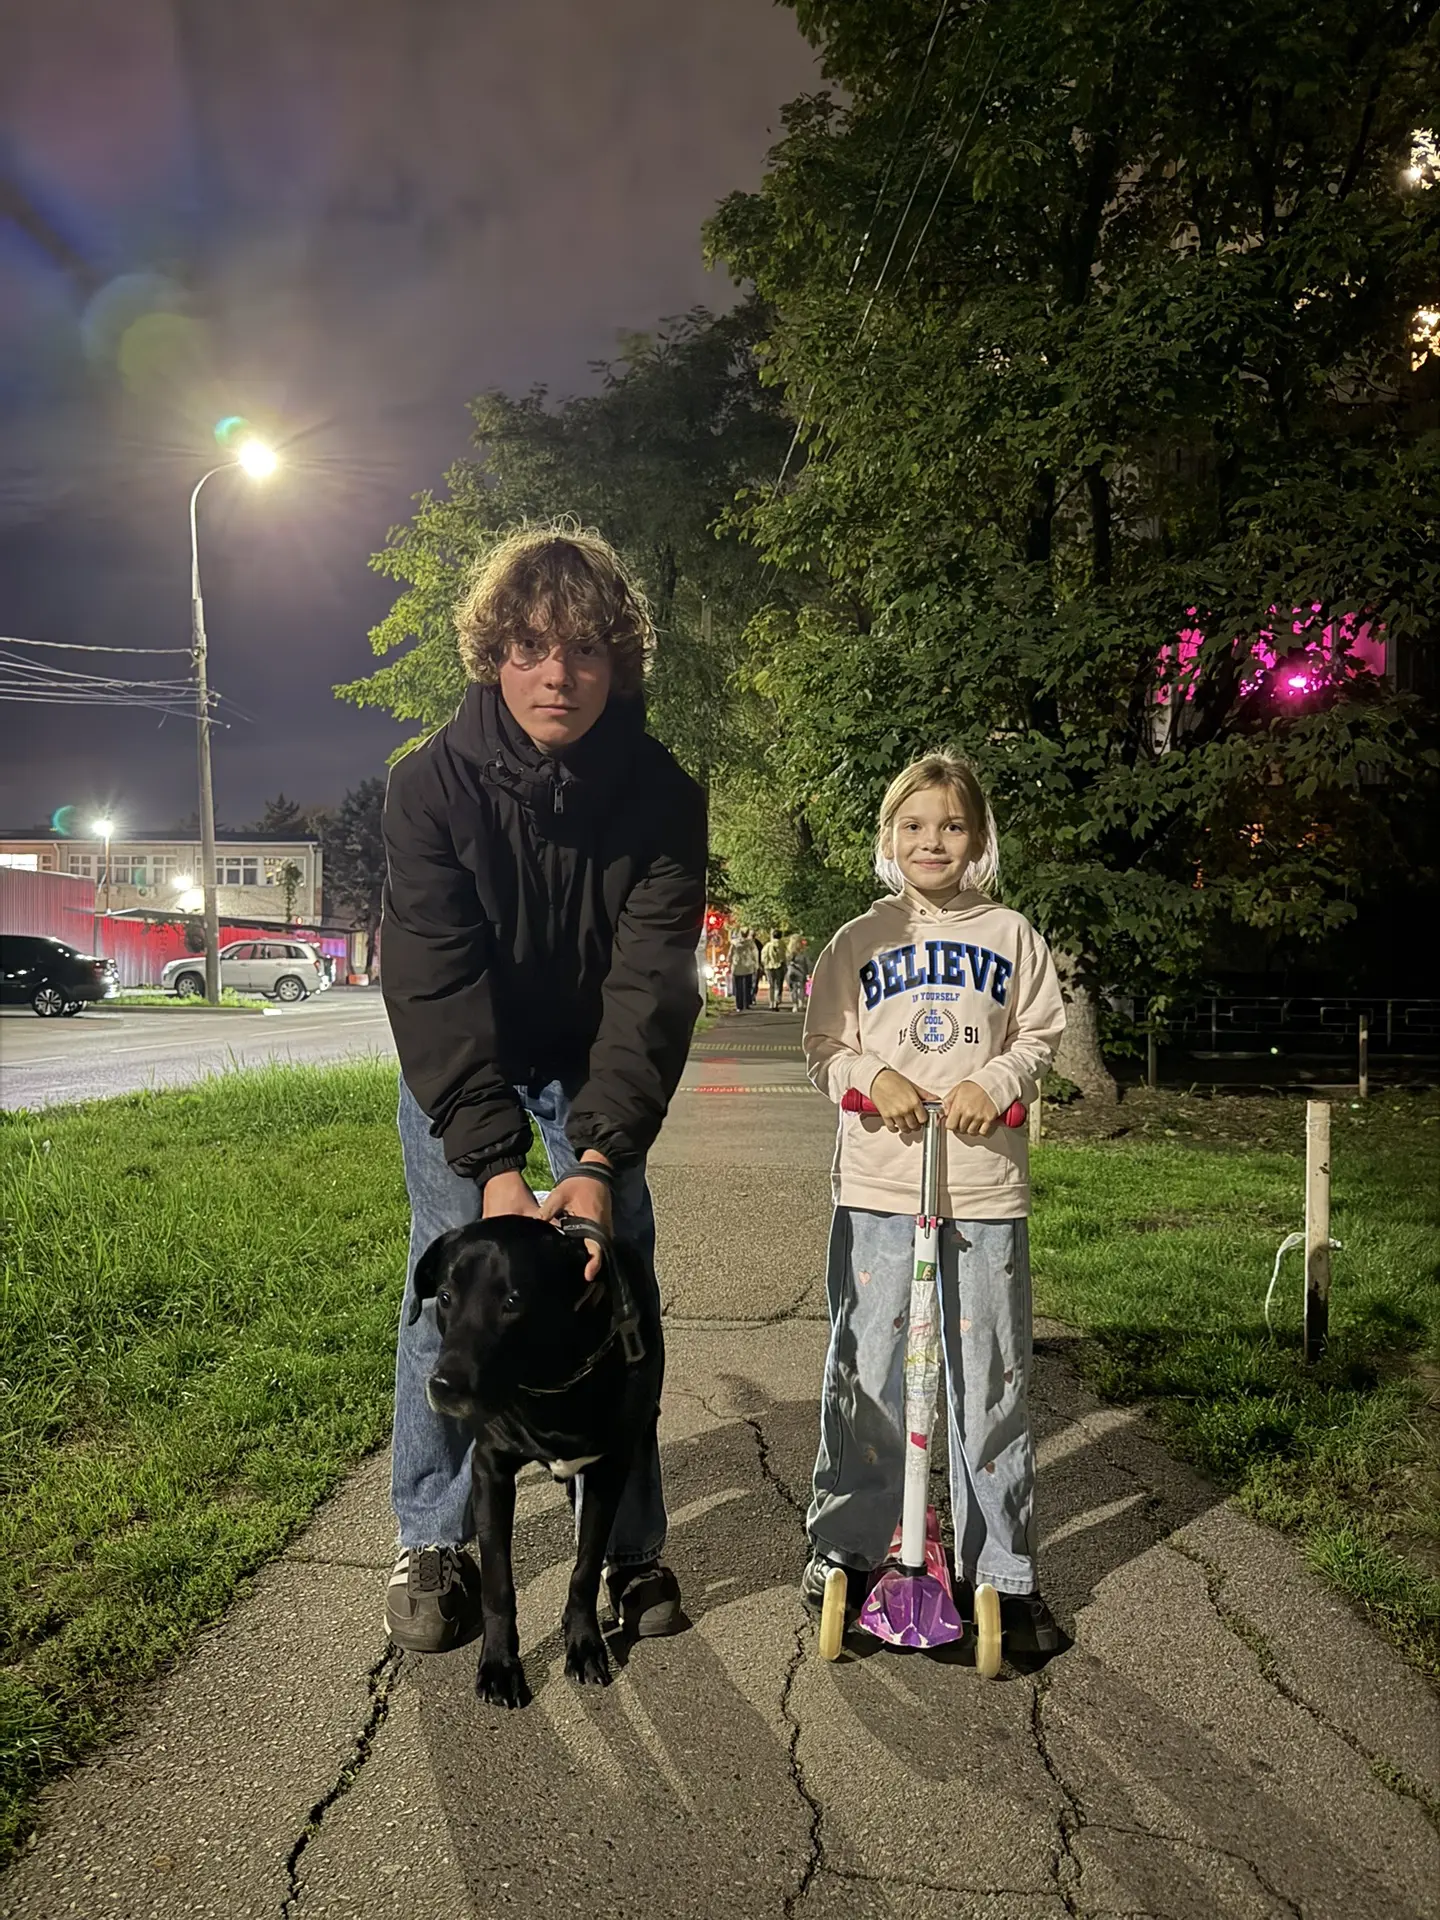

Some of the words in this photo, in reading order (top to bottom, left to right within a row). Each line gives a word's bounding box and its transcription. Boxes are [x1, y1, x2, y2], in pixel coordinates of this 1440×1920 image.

[859, 941, 1014, 1011] BELIEVE
[920, 992, 961, 1001] YOURSELF
[924, 1016, 943, 1025] COOL
[923, 1033, 945, 1042] KIND
[964, 1026, 979, 1044] 91
